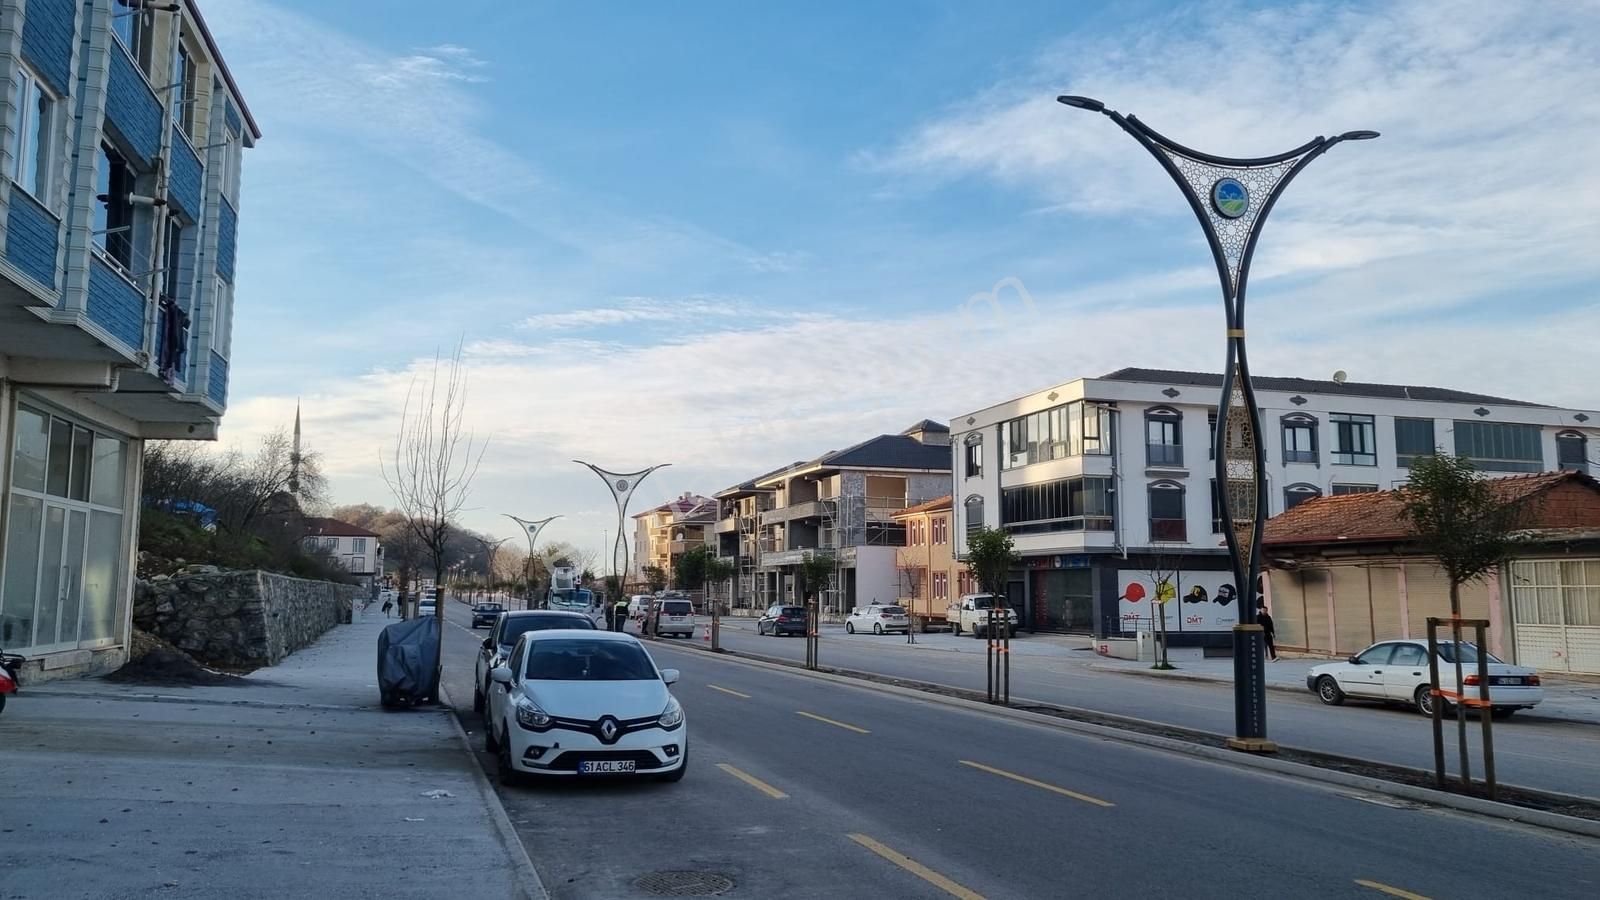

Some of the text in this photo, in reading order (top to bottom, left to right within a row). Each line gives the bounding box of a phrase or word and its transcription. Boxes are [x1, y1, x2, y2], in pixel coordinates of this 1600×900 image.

[584, 761, 635, 772] 61 ACL 346
